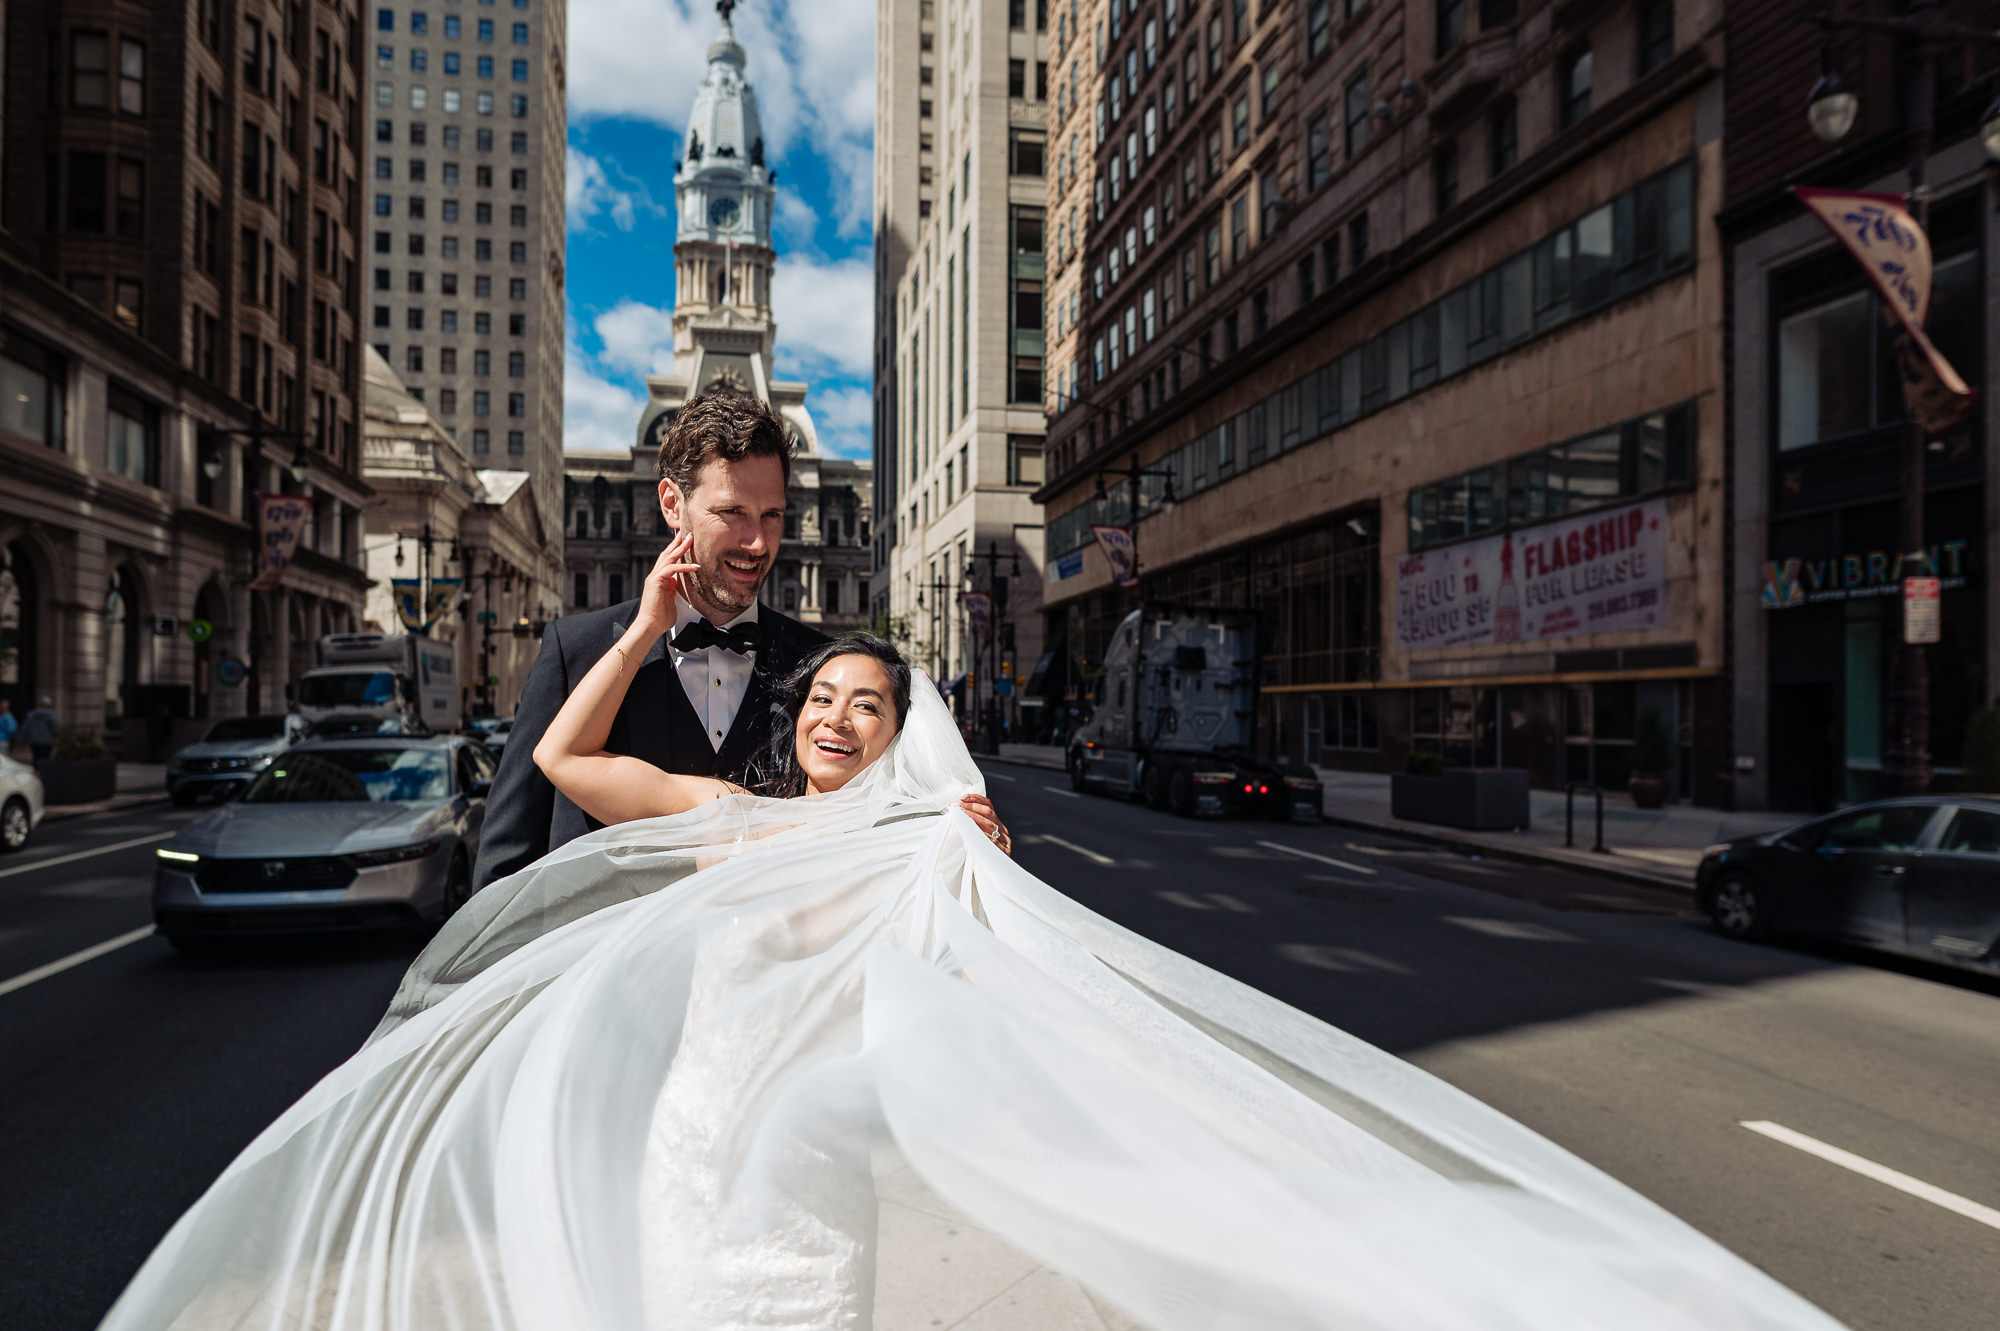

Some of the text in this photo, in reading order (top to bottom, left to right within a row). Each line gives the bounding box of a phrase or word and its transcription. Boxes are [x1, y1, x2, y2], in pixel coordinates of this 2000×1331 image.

[1524, 508, 1644, 579] FLAGSHIP
[1525, 550, 1648, 608] FOR LEASE
